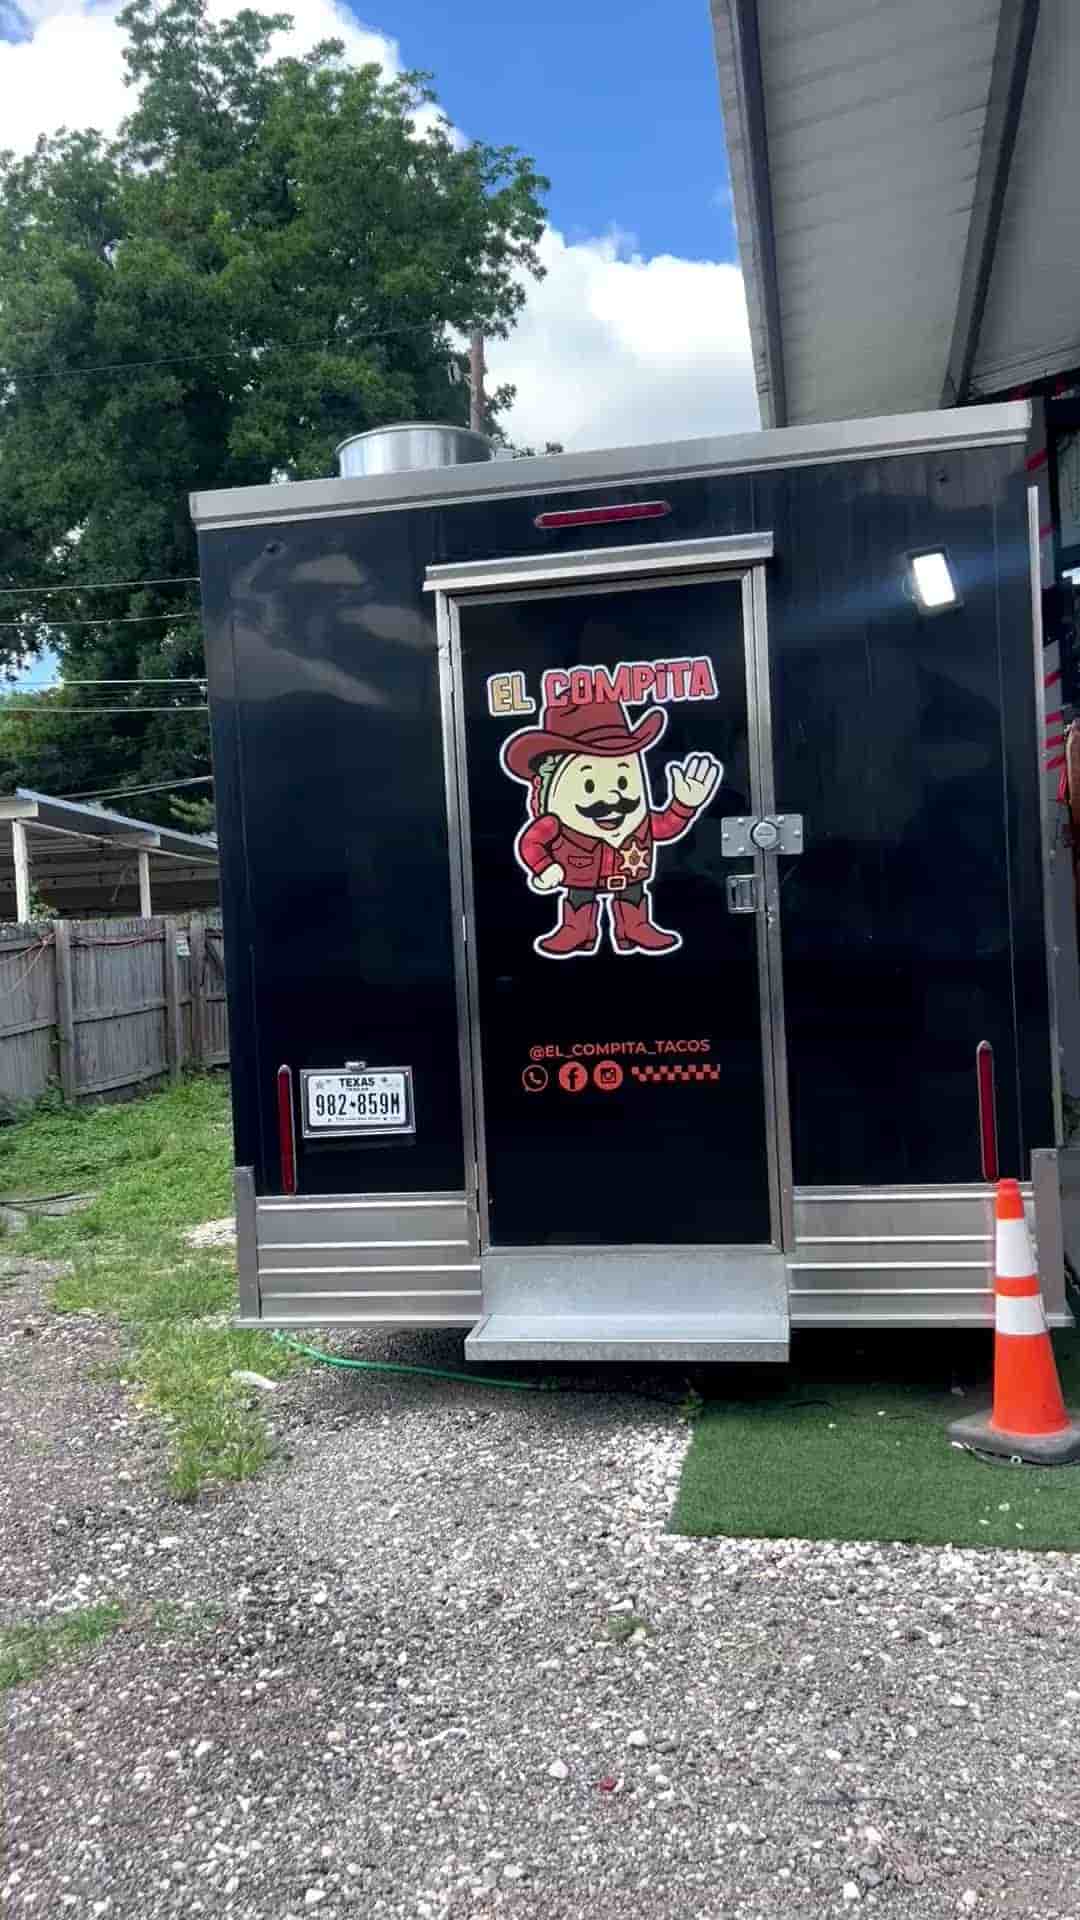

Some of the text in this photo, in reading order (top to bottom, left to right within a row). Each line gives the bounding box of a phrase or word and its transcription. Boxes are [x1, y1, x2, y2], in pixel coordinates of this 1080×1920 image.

[489, 673, 535, 715] EL
[529, 1039, 711, 1061] @EL_COMPITA_TACOS
[339, 1077, 375, 1088] TEXAS
